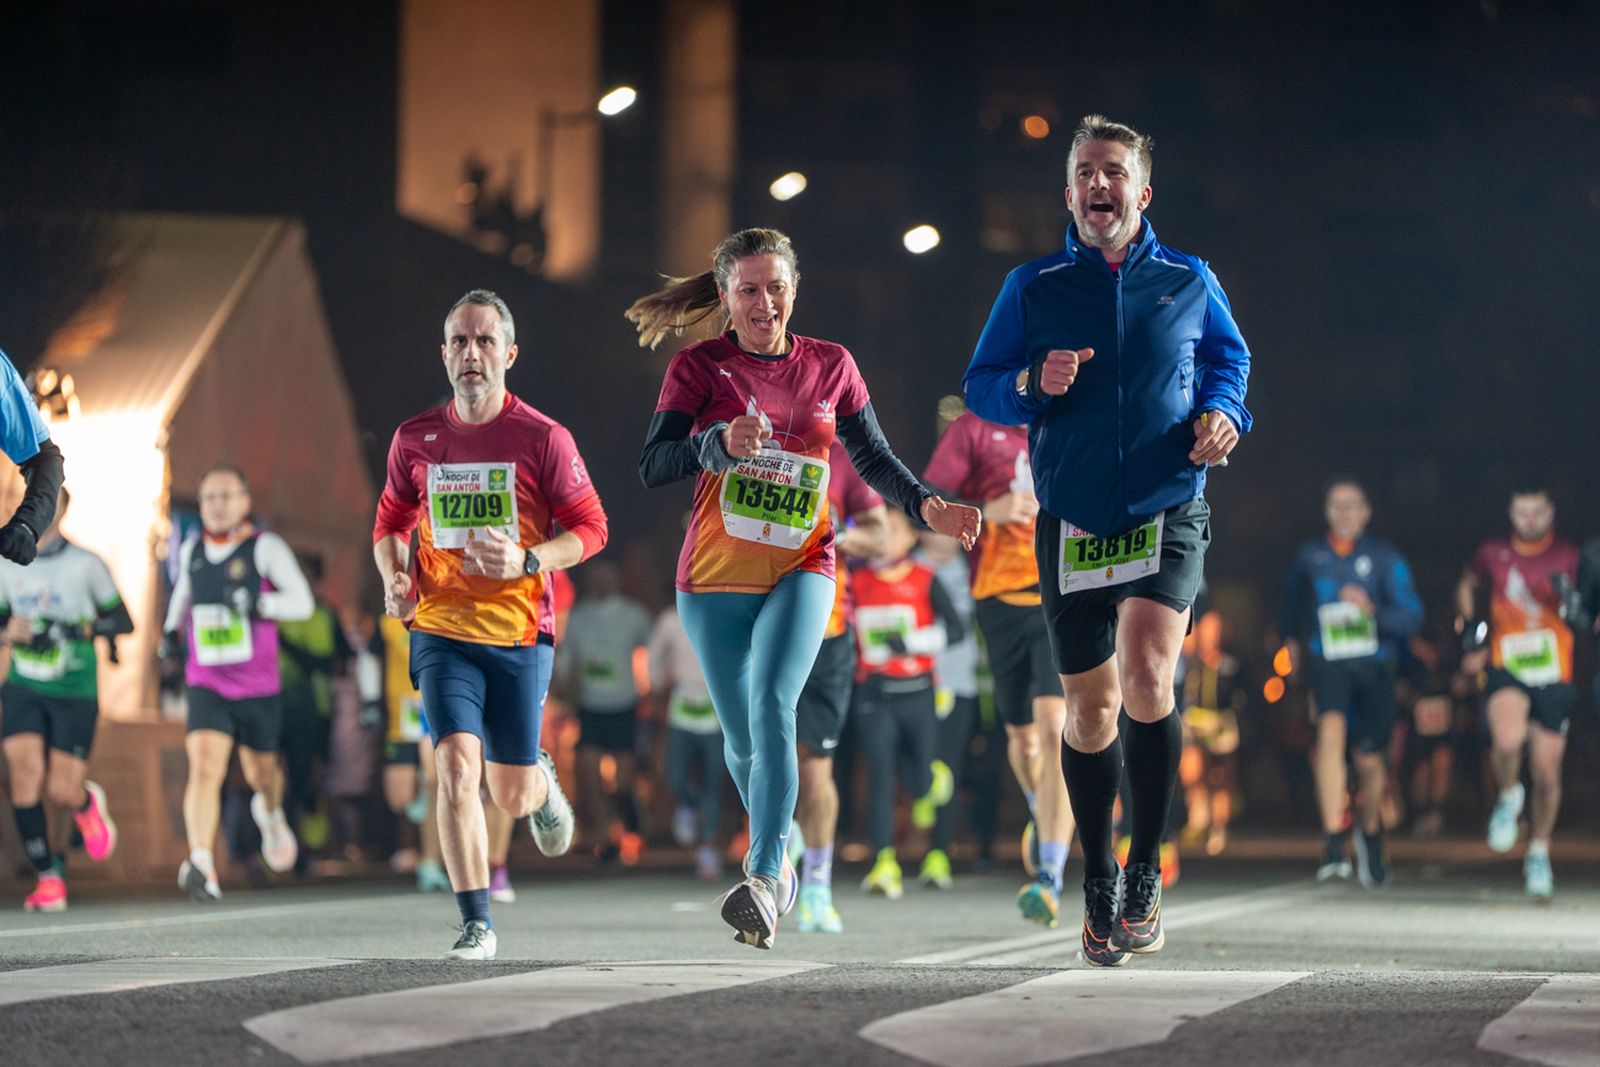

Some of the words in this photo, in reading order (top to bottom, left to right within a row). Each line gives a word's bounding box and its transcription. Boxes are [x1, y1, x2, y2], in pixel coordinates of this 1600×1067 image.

[736, 464, 758, 477] SAN
[751, 458, 782, 471] NOCHE
[782, 463, 794, 473] DE
[446, 473, 470, 481] NOCHE
[470, 472, 480, 481] DE
[436, 483, 452, 492] SAN
[439, 493, 503, 519] 12709
[736, 479, 811, 518] 13544
[1075, 528, 1147, 562] 13819
